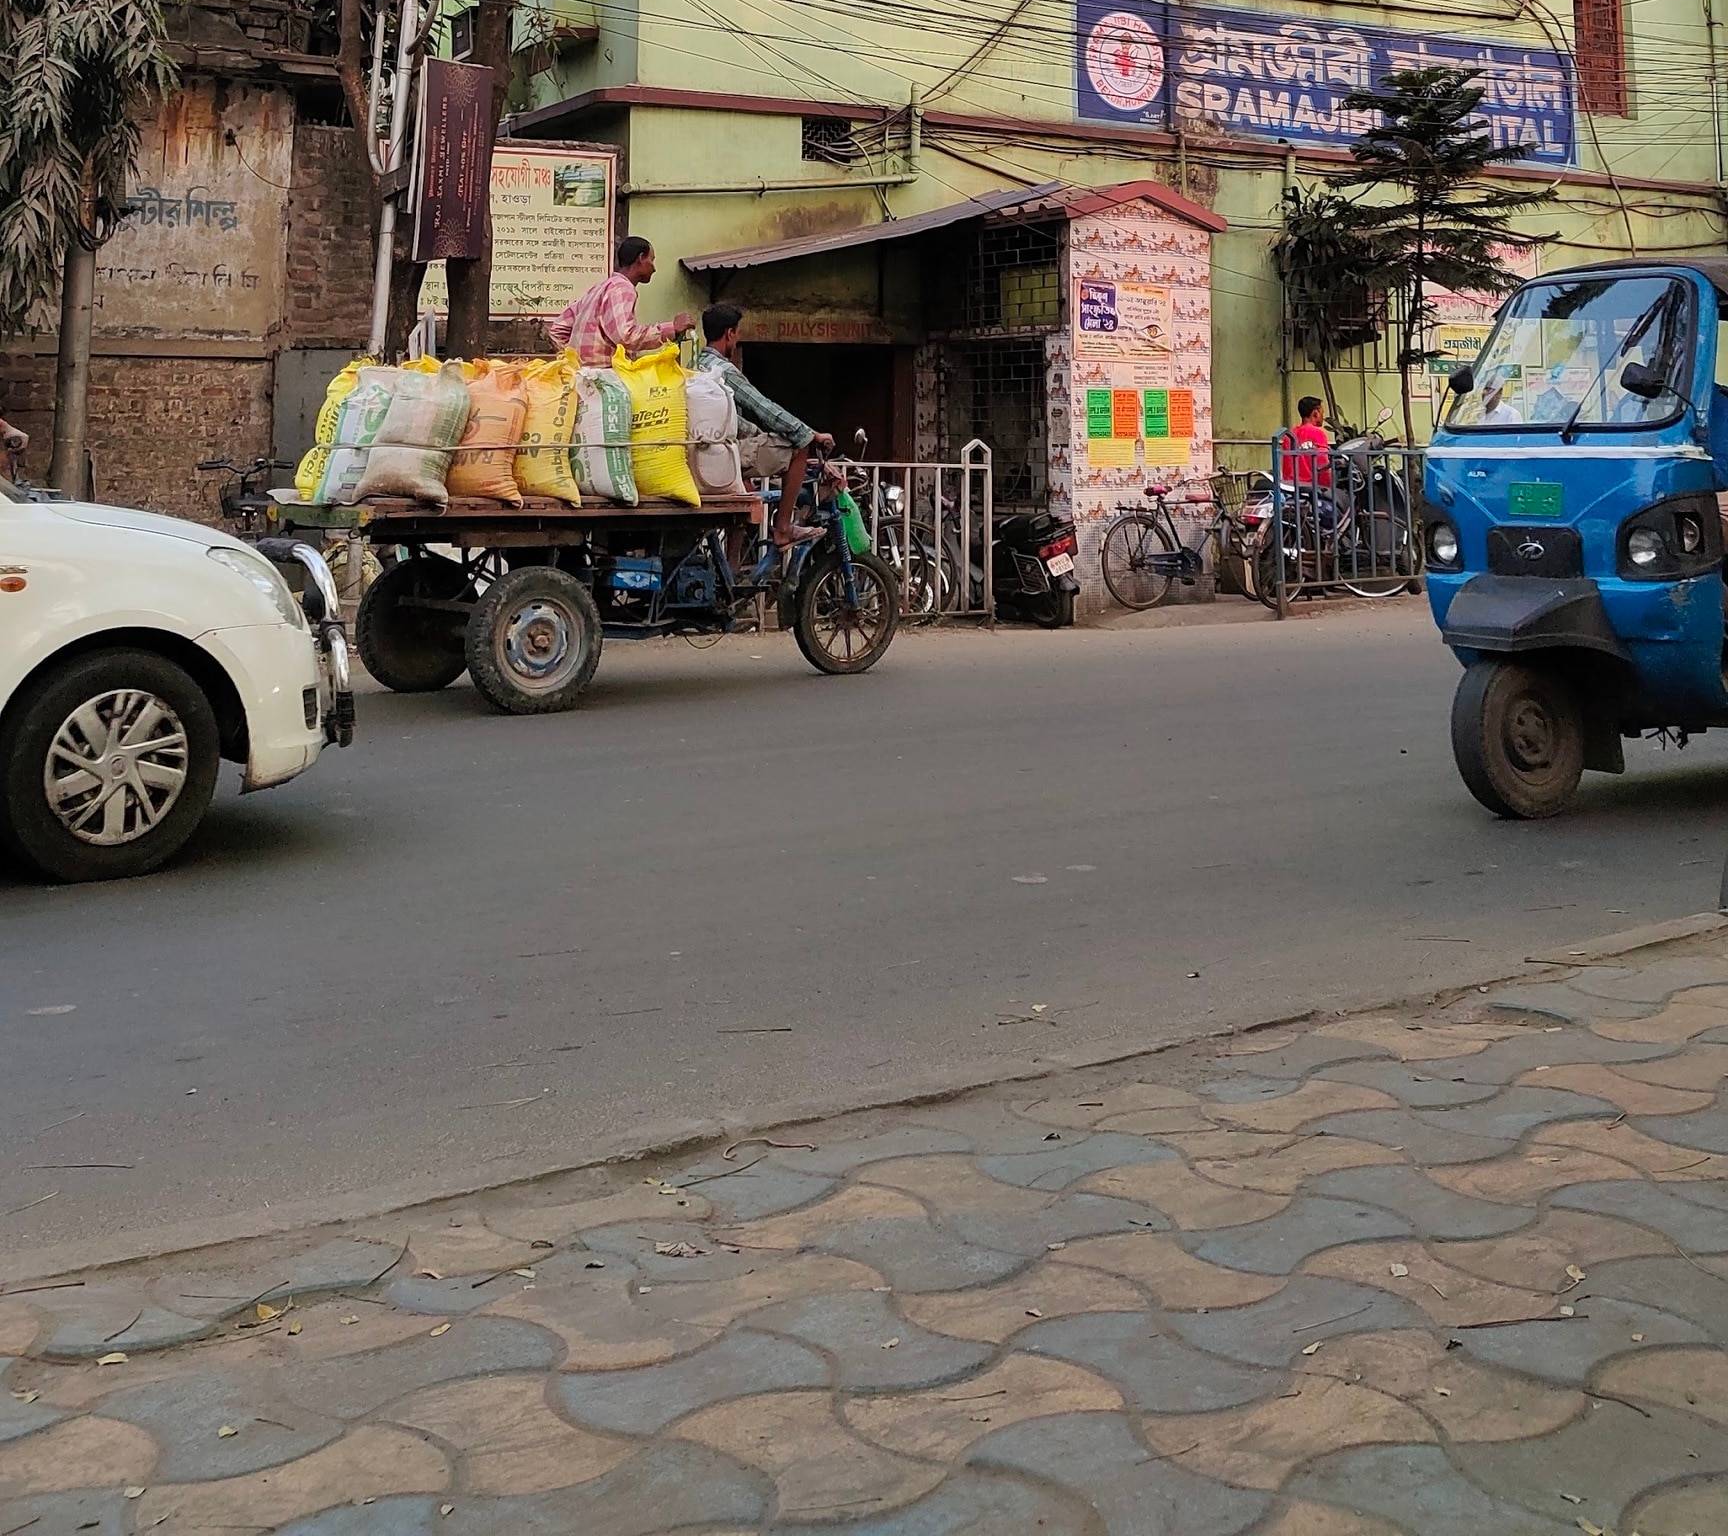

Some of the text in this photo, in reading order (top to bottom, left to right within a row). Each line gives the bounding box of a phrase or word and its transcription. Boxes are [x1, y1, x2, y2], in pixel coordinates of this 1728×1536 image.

[1174, 81, 1385, 138] SRAMAJIBI
[777, 322, 872, 338] DIALYSIS UNIT
[631, 406, 669, 422] aTech
